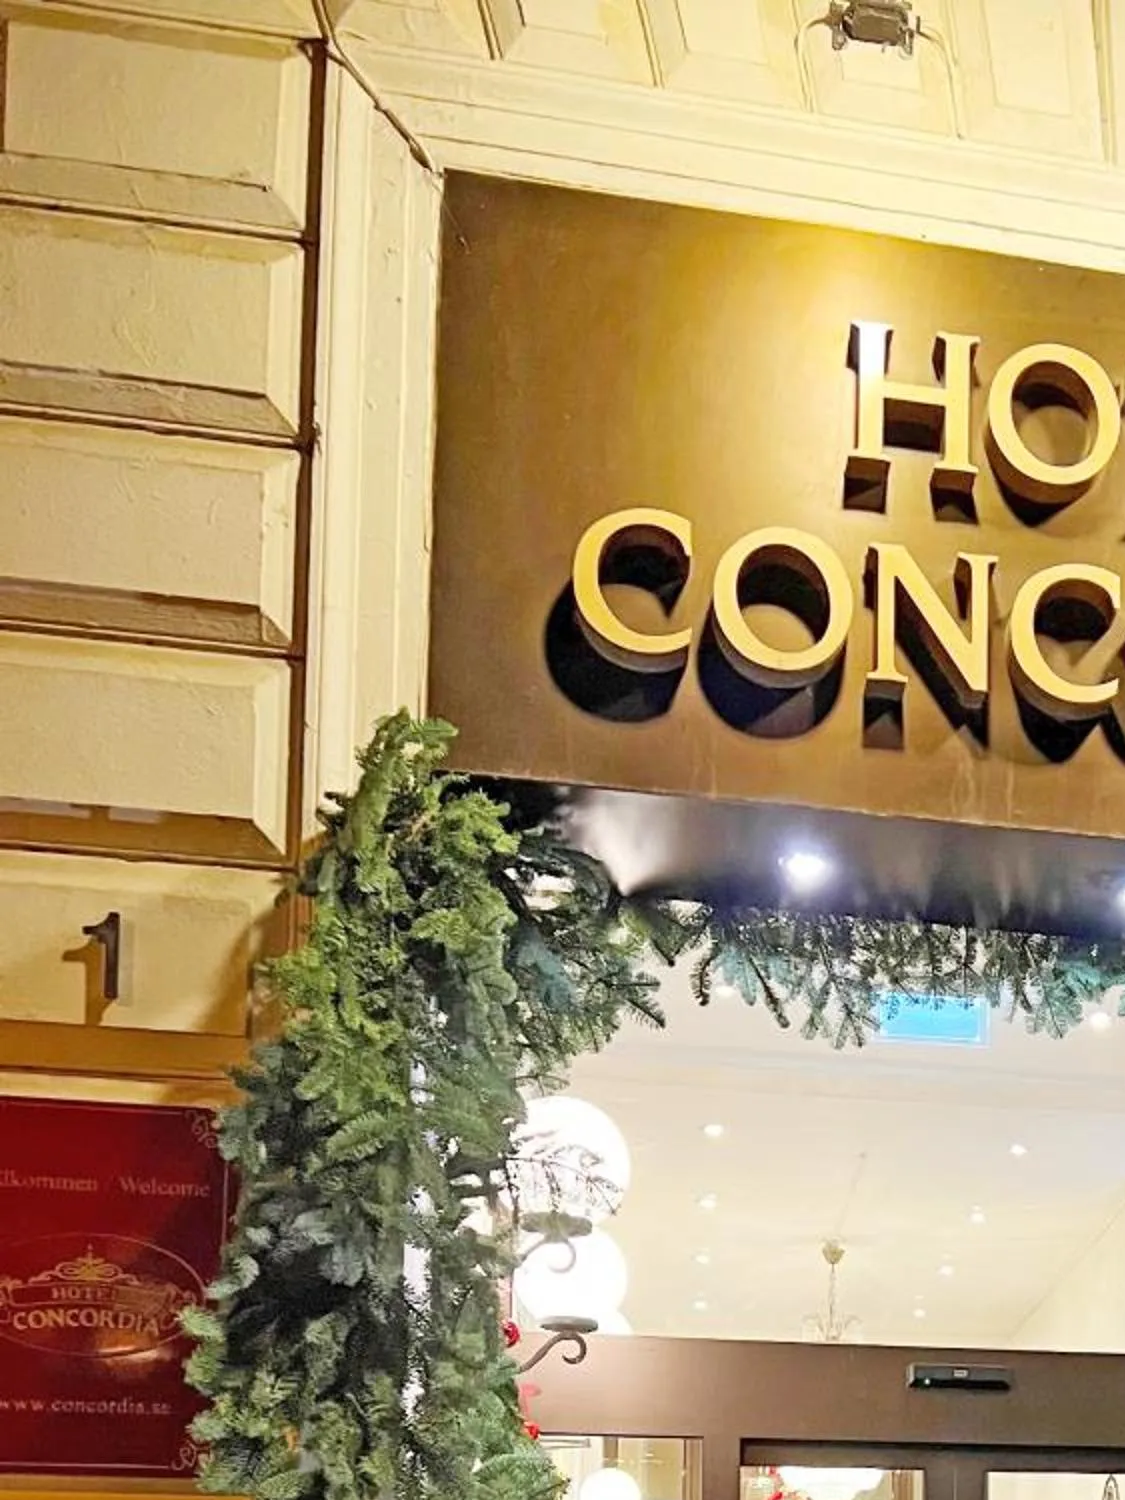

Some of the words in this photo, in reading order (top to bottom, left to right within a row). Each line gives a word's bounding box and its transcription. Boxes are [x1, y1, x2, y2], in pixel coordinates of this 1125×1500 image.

[82, 911, 121, 1000] 1
[119, 1175, 211, 1197] Welcome
[51, 1286, 117, 1300] HOTEL
[13, 1307, 160, 1336] CONCORDIA
